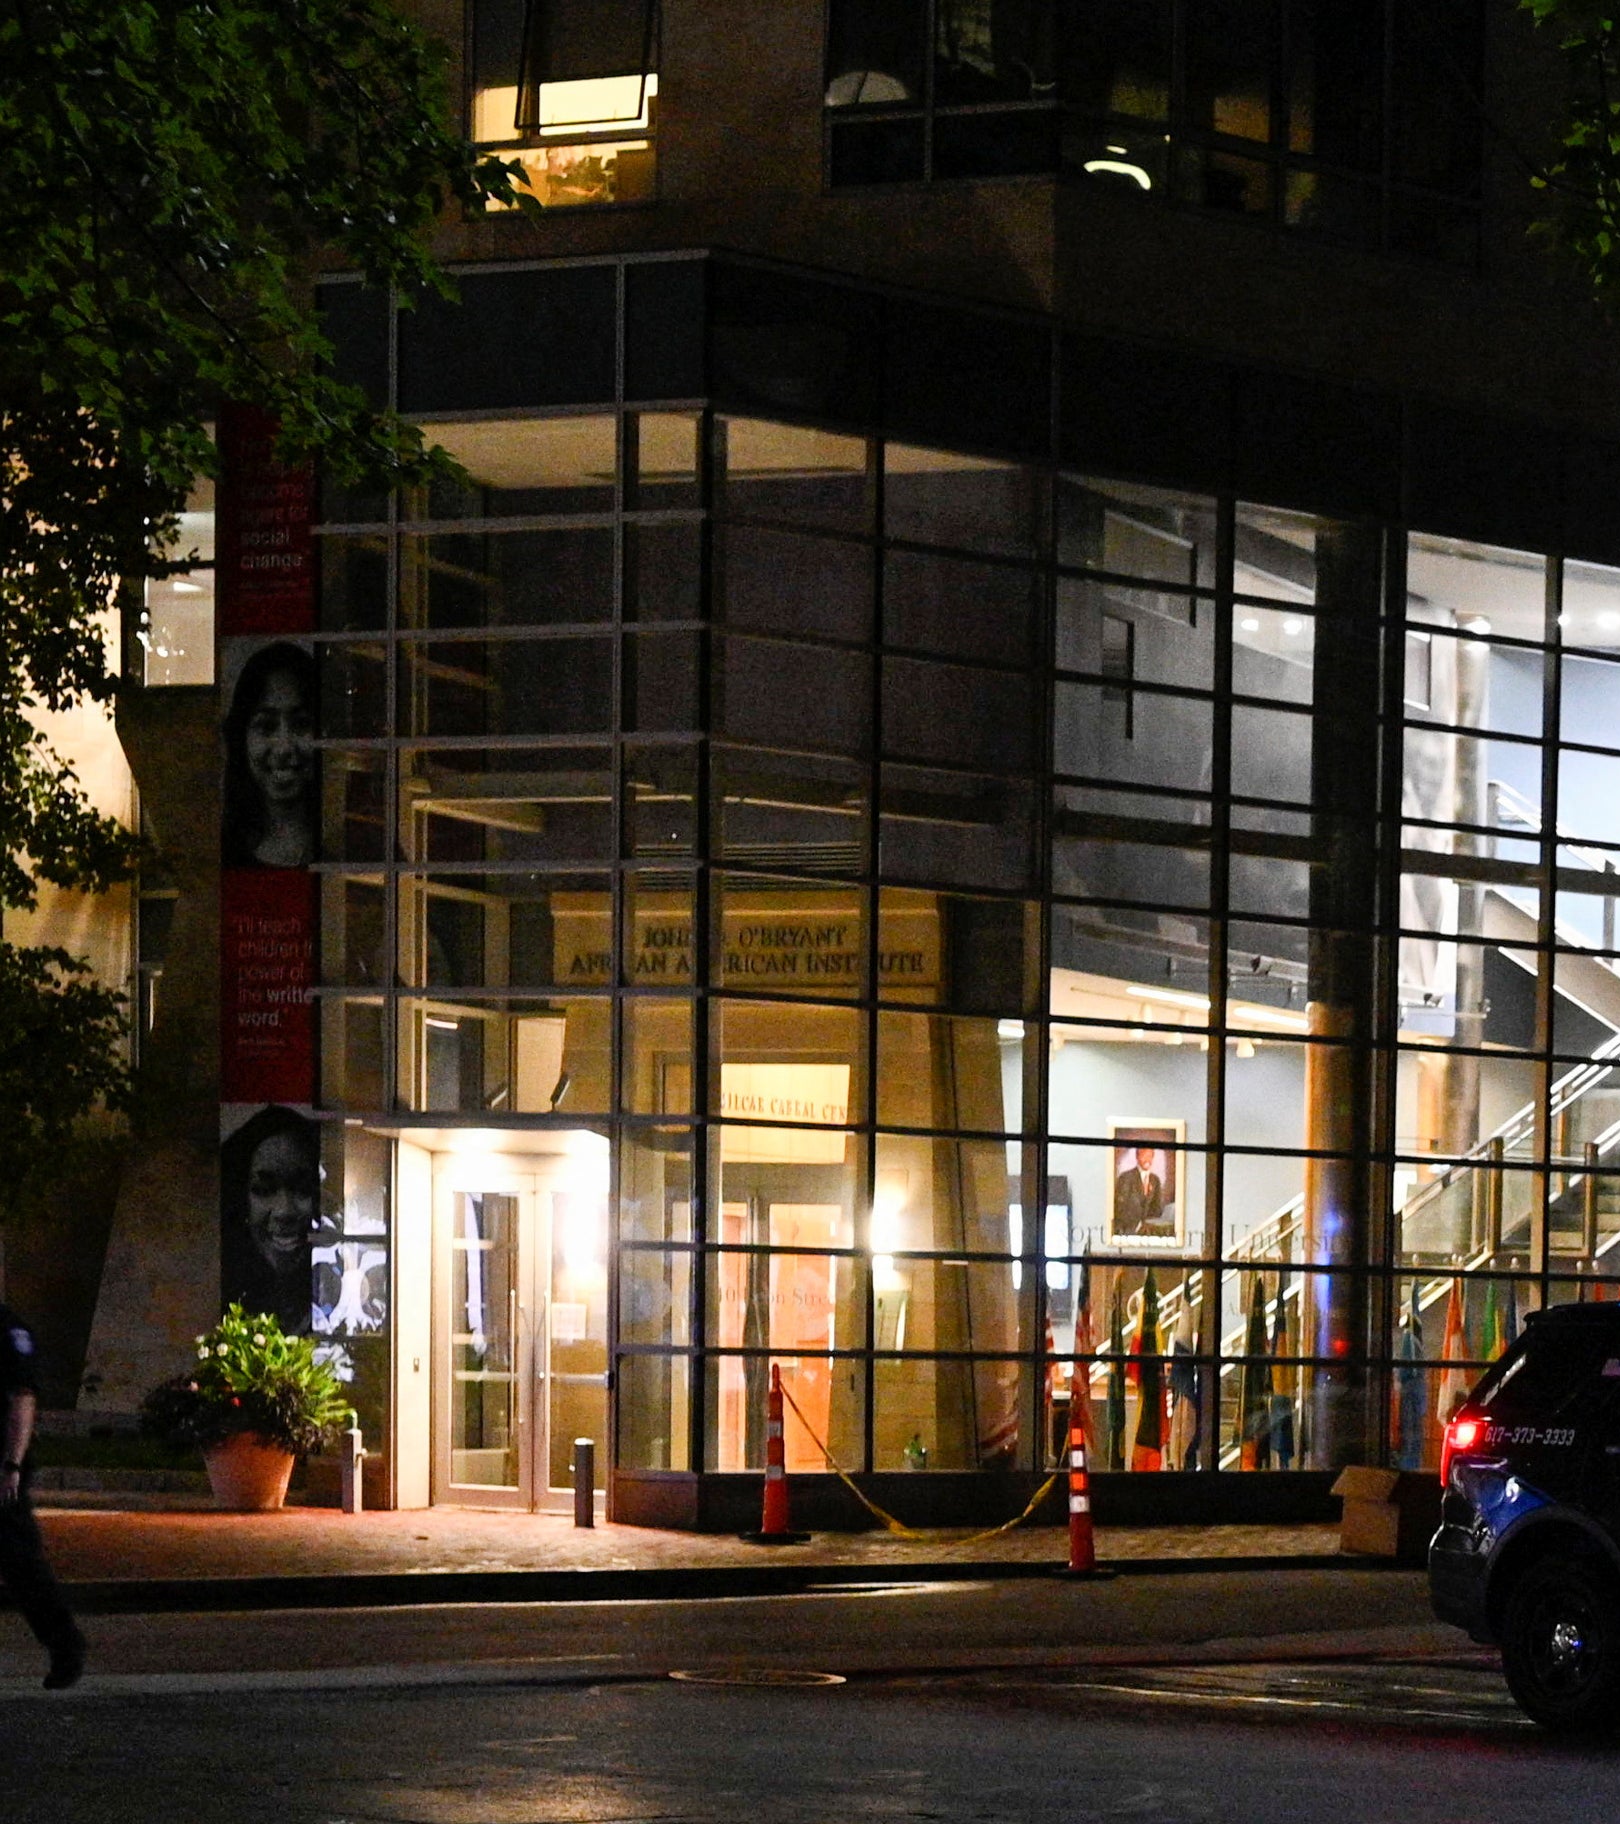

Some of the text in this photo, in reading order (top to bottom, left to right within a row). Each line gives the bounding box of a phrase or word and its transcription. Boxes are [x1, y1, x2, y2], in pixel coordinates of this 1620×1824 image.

[241, 525, 291, 547] social
[738, 925, 848, 948] O'BRYANT
[238, 940, 299, 958] children
[238, 965, 285, 983] power
[675, 952, 797, 975] ARICAN
[805, 952, 924, 975] INSTUTE
